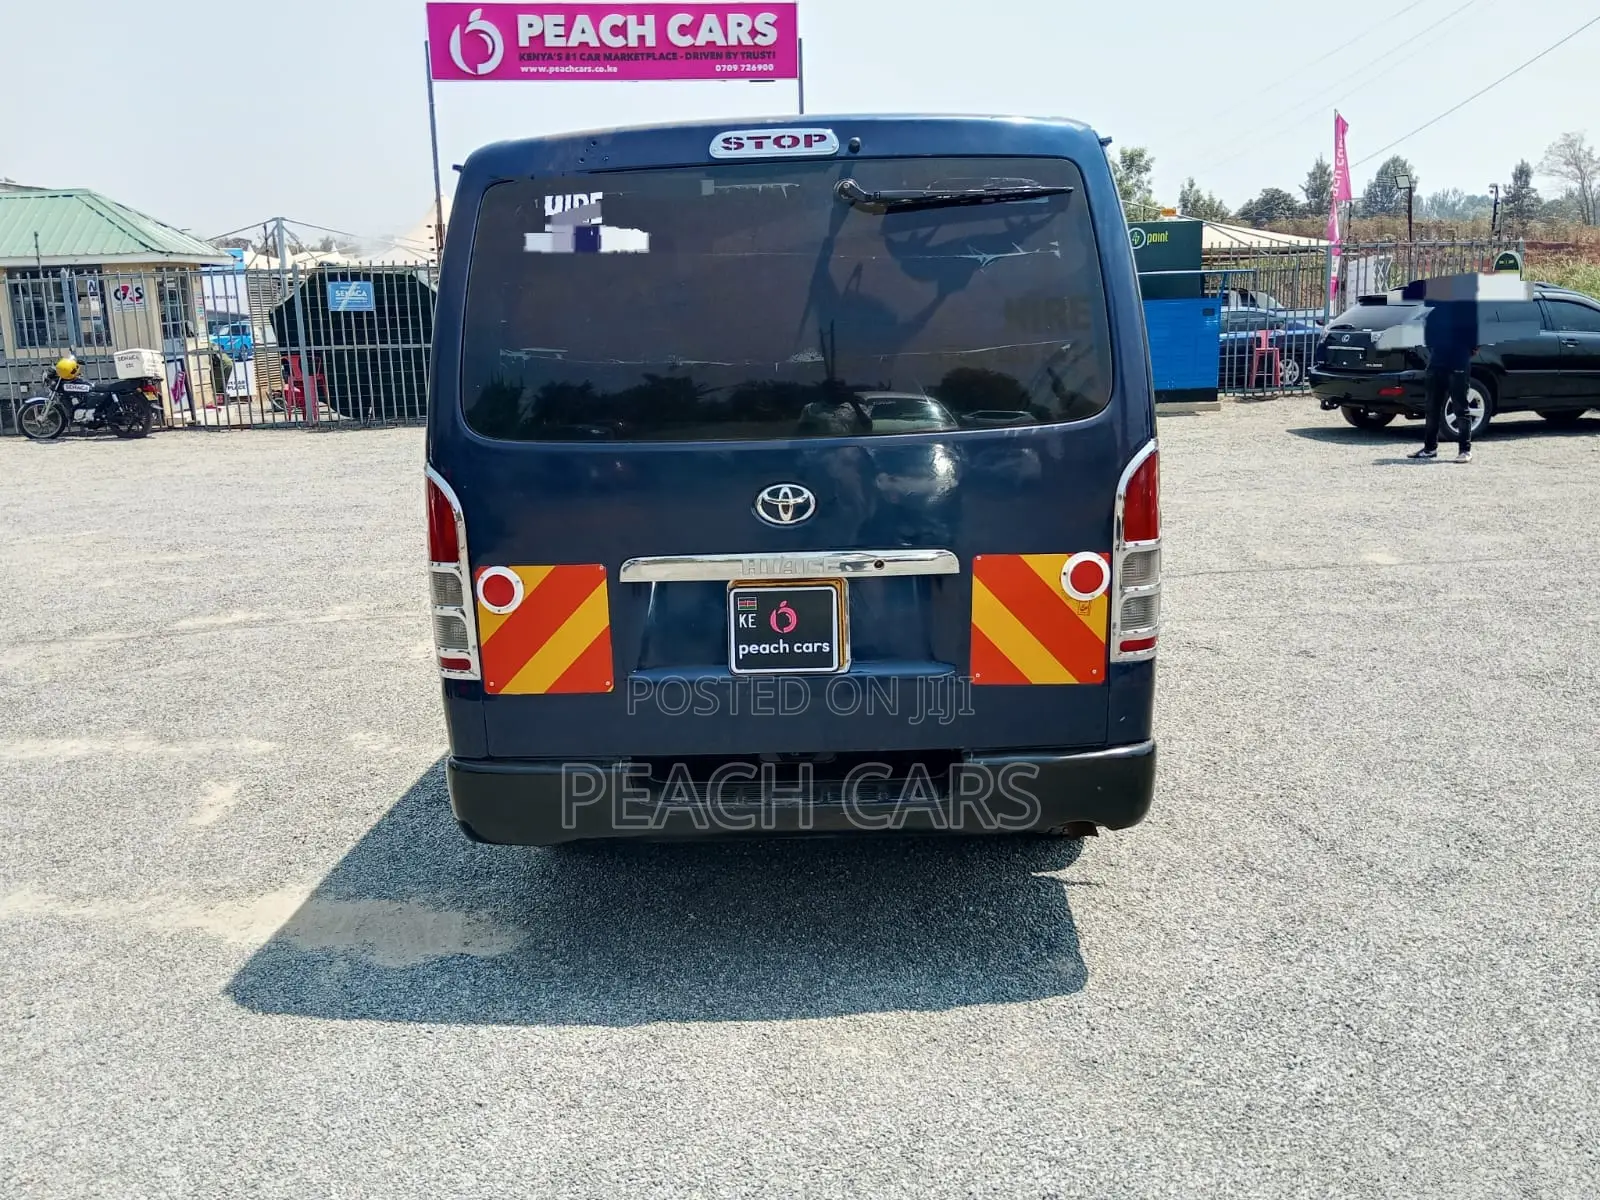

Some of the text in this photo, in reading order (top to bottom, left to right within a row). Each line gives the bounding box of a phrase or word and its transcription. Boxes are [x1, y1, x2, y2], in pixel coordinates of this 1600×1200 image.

[517, 12, 778, 48] PEACH CARS
[519, 52, 562, 61] KENYA'S
[580, 52, 600, 61] CAR
[603, 52, 678, 61] MARKETPLACE
[685, 51, 723, 60] DRIVEN
[726, 51, 738, 60] BY
[741, 50, 776, 60] TRUST!
[520, 63, 774, 74] www.peachcars.co.ke 0709 726900
[721, 133, 827, 151] STOP
[1146, 230, 1169, 246] point
[742, 557, 841, 576] HIACE
[739, 613, 757, 628] KE
[738, 638, 830, 660] peach cars
